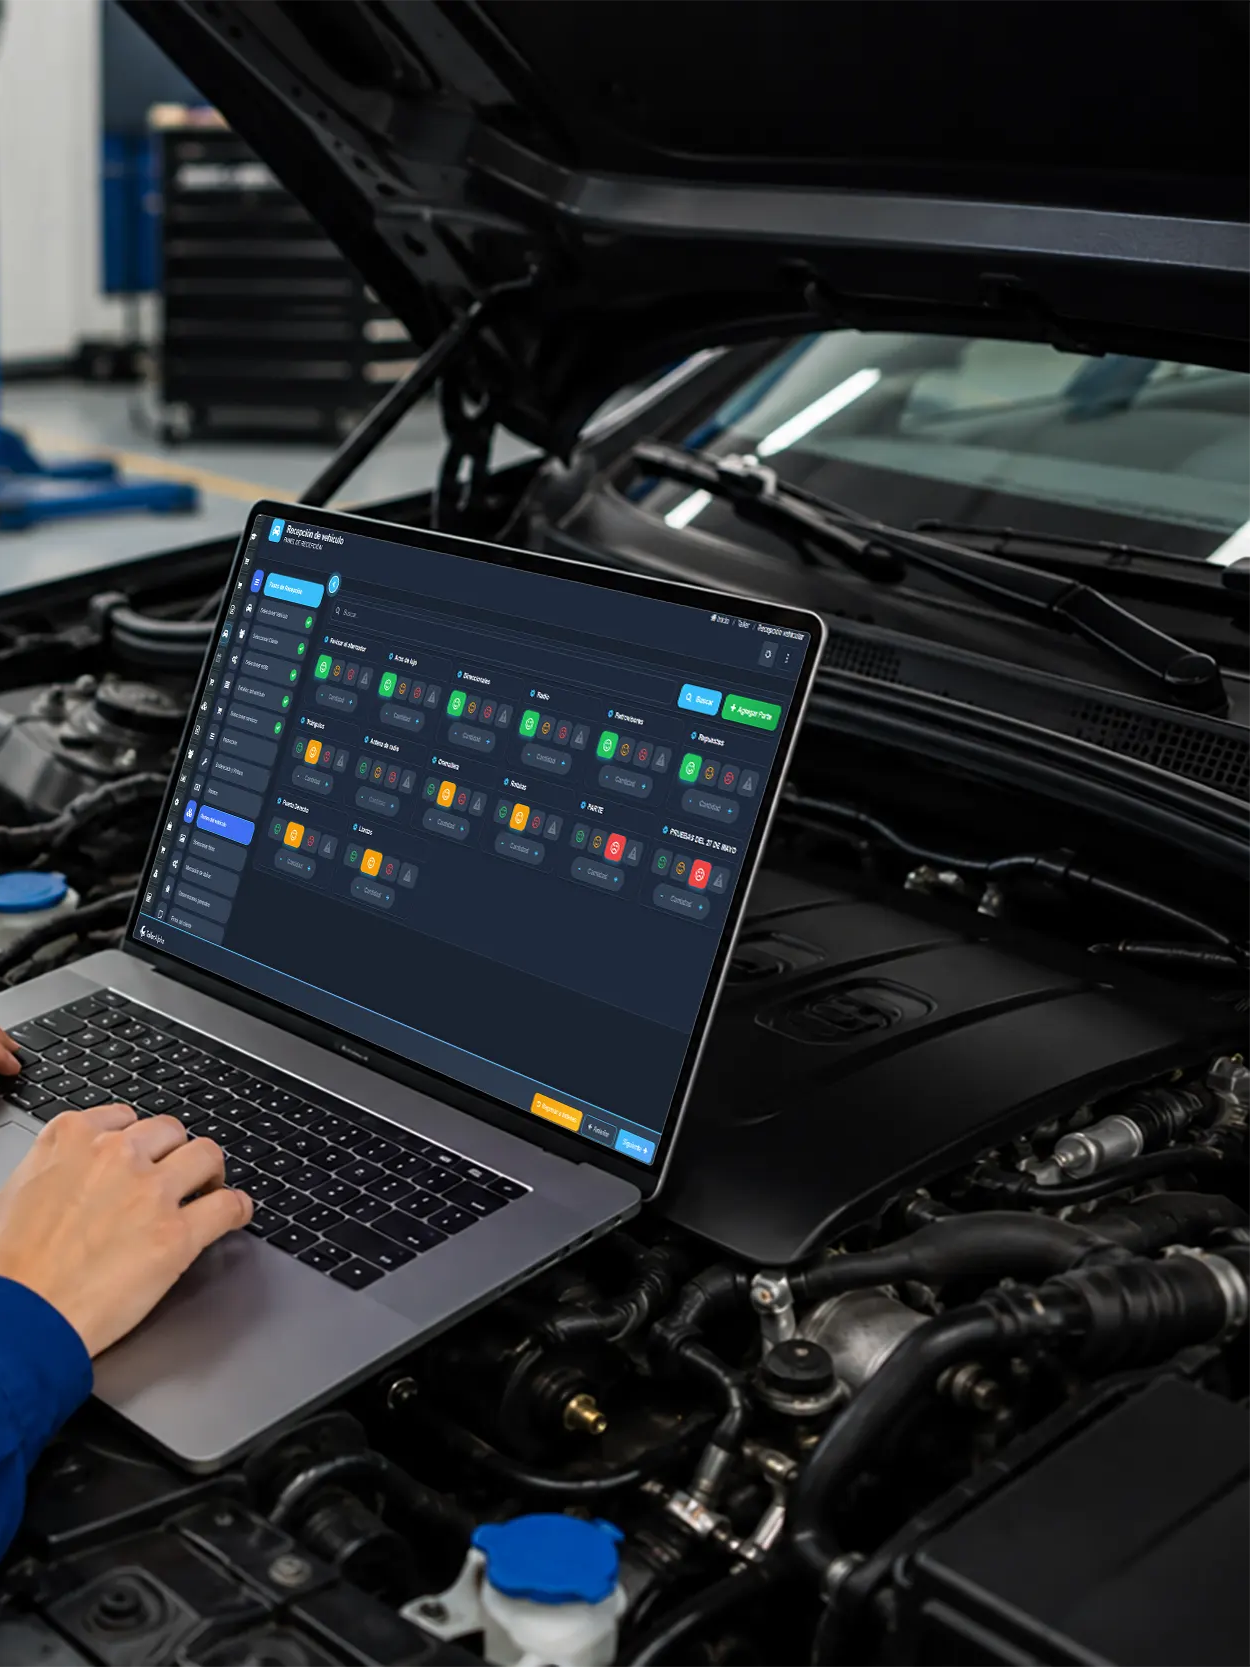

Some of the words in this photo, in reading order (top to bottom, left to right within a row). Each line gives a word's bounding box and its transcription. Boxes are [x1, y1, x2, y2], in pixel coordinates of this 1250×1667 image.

[286, 525, 314, 538] Recepción
[314, 531, 321, 540] de
[696, 696, 714, 706] Buscar
[587, 803, 604, 815] PARTE
[669, 828, 694, 843] PRUEBAS
[695, 835, 704, 845] DEL
[713, 840, 720, 849] DE
[721, 843, 737, 854] MAYO
